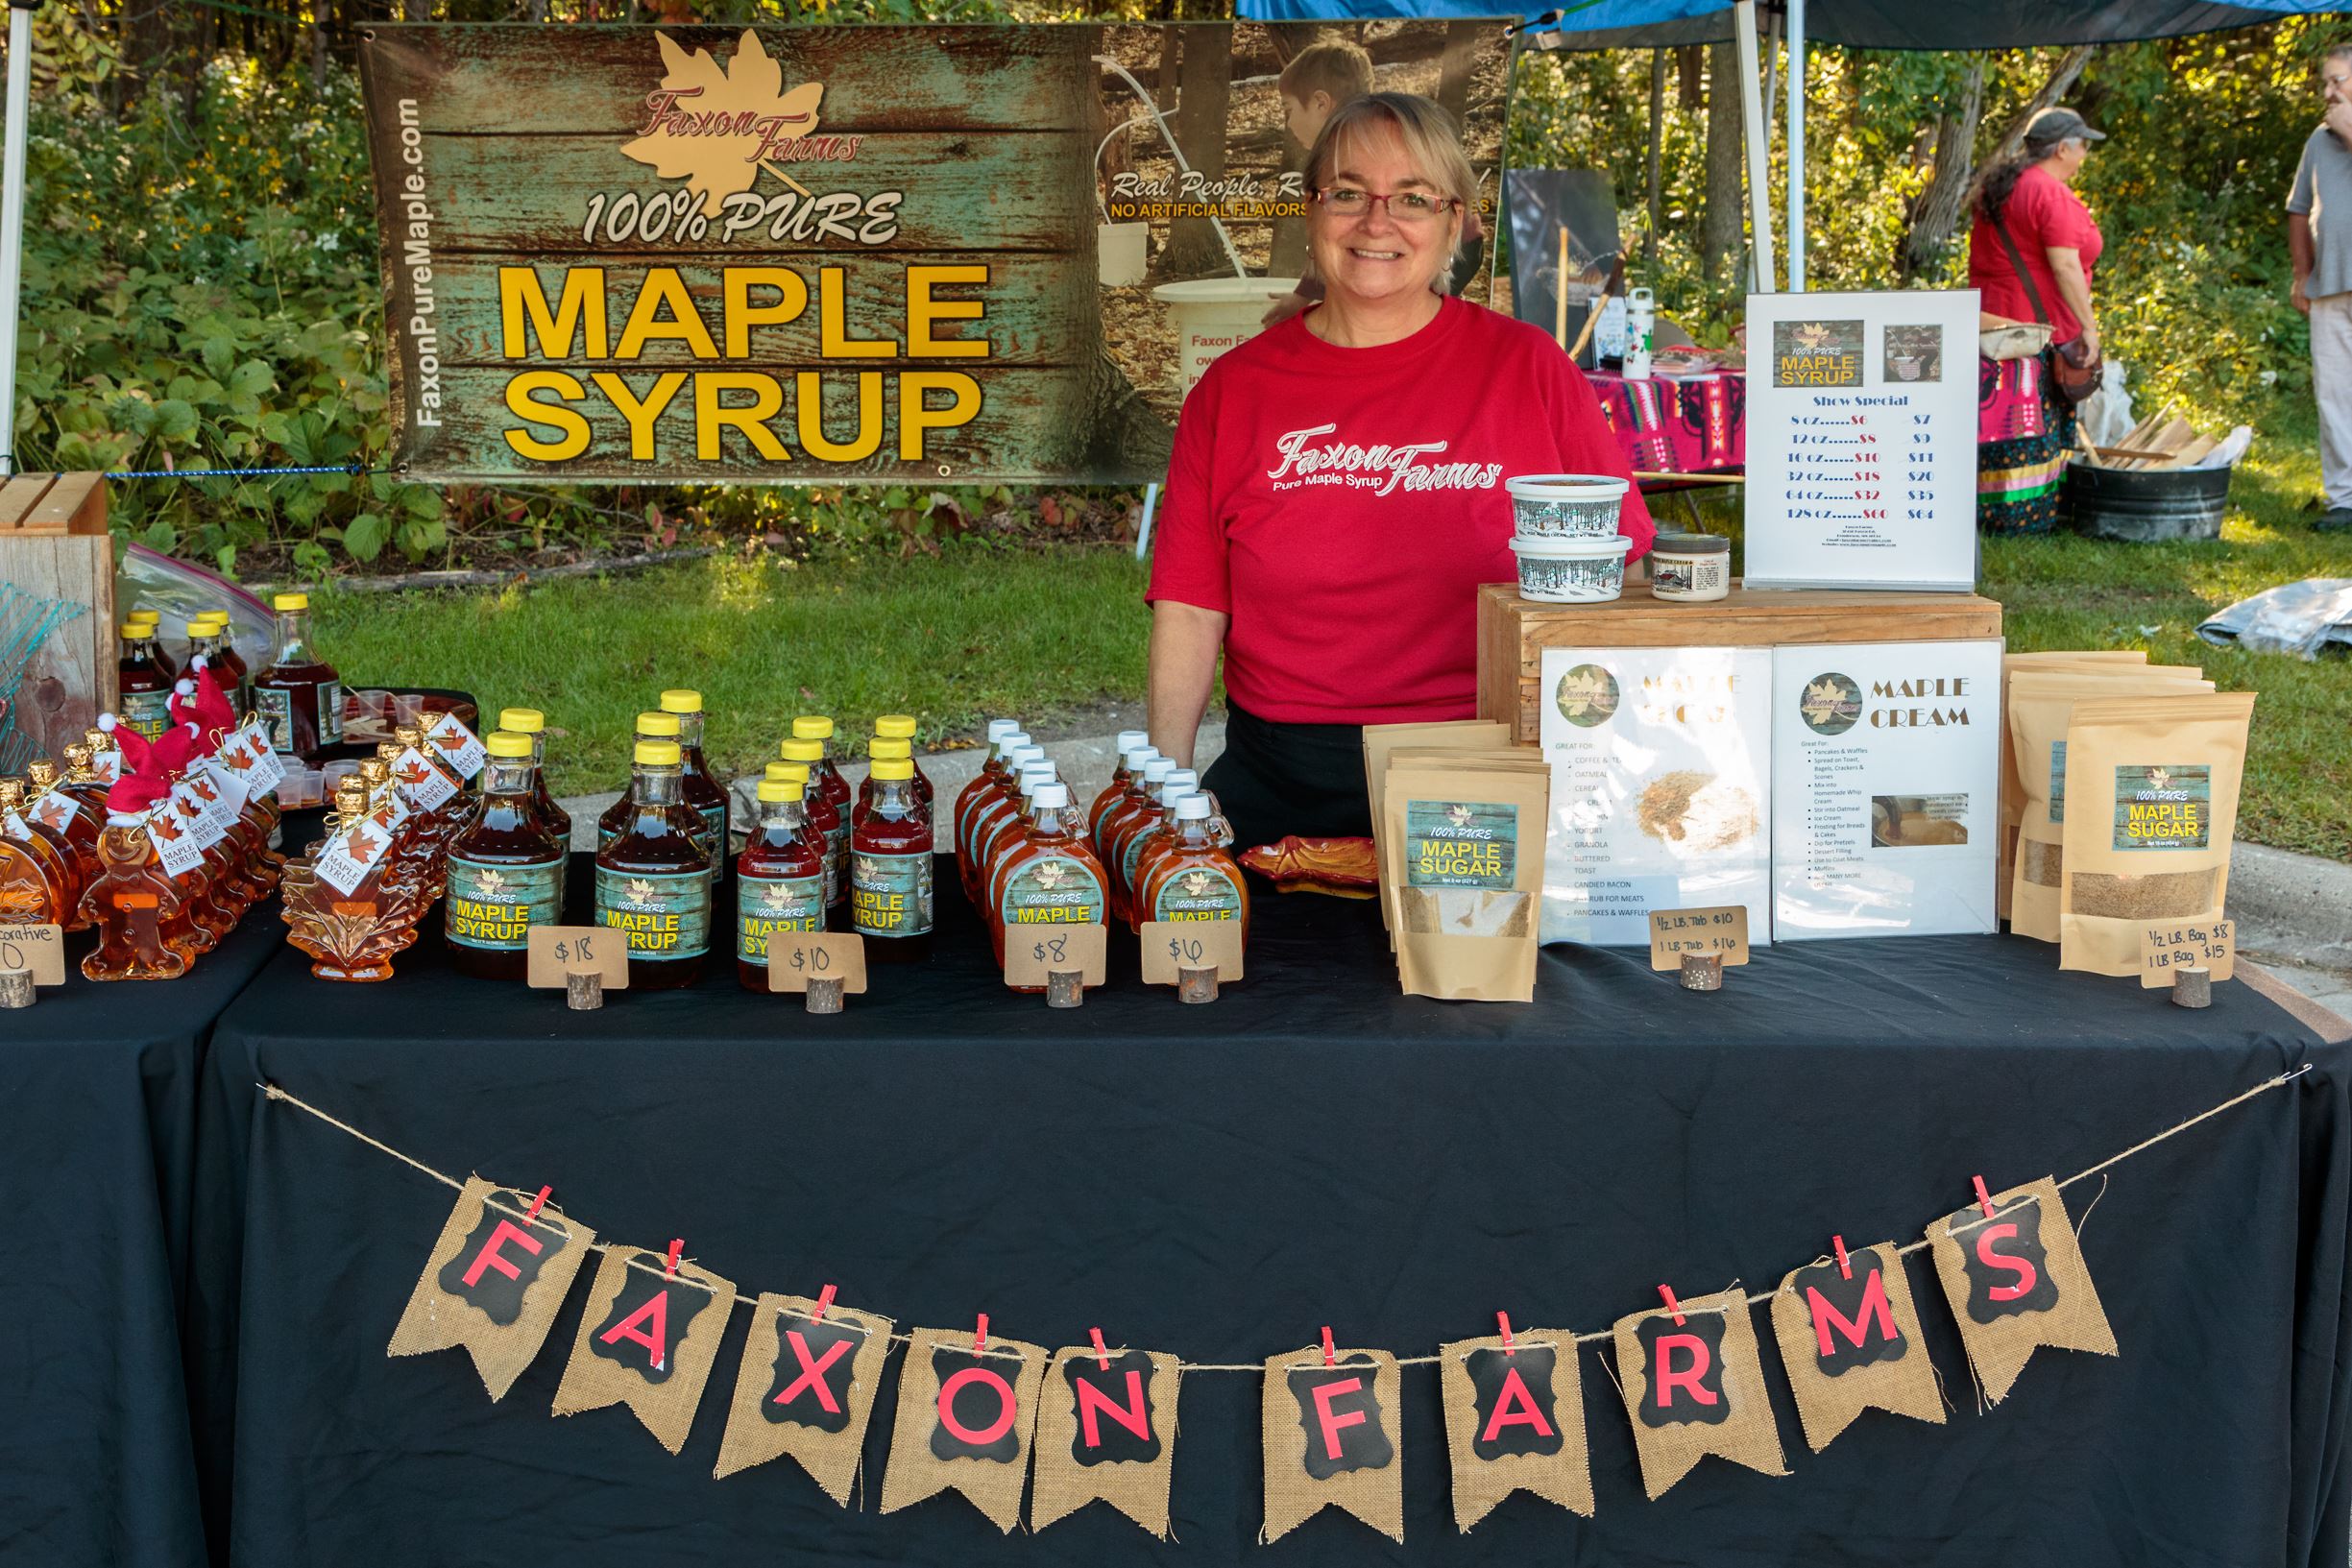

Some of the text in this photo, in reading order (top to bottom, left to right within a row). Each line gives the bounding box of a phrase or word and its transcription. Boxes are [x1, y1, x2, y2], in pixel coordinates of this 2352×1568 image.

[636, 84, 863, 162] Faxon Farms
[1111, 172, 1172, 197] Real
[582, 192, 905, 243] 100% PURE
[1111, 203, 1136, 217] NO
[1139, 203, 1230, 217] ARTIFICIAL
[401, 98, 444, 428] FaxonPureMaple.com
[498, 265, 989, 360] MAPLE
[1192, 336, 1232, 347] Faxon
[1782, 355, 1855, 371] MAPLE
[1782, 371, 1855, 385] SYRUP
[1812, 395, 1908, 407] Show Special
[502, 370, 982, 462] SYRUP
[1267, 422, 1503, 497] Faxon Farms
[1273, 472, 1383, 492] Pure Maple Syrup
[1870, 677, 1971, 699] MAPLE
[1870, 707, 1971, 729] CREAM
[456, 744, 482, 768] MAPLE
[417, 779, 446, 804] MAPLE
[423, 784, 450, 809] SYRUP
[2136, 790, 2189, 801] 100% PURE
[2129, 804, 2197, 821] MAPLE
[192, 819, 216, 836] MAPLE
[196, 825, 222, 843] SYRUP
[1430, 827, 1492, 839] 100% PURE
[2127, 821, 2198, 838] SUGAR
[163, 844, 195, 861] MAPLE
[167, 850, 198, 868] SYRUP
[1422, 840, 1500, 859] MAPLE
[322, 860, 356, 888] SYRUP
[327, 854, 361, 881] MAPLE
[1419, 857, 1501, 877] SUGAR
[467, 890, 517, 904] 100% PURE
[617, 901, 666, 912] 100% PURE
[854, 891, 904, 911] APLE
[1026, 893, 1081, 904] 100% PURE
[1176, 899, 1224, 908] 100% PURE
[456, 899, 529, 922] MAPLE
[607, 909, 679, 931] MAPLE
[756, 907, 806, 917] 100% PURE
[854, 909, 903, 929] YRUP
[1018, 905, 1090, 923] MAPLE
[1713, 913, 1734, 925] $10
[456, 917, 527, 940] SYRUP
[2168, 930, 2186, 945] LB.
[2188, 929, 2207, 947] Bag
[2213, 924, 2228, 939] $8
[1667, 941, 1681, 952] LB
[1712, 937, 1735, 950] $16
[789, 947, 830, 972] $10
[2157, 953, 2170, 967] LB
[2173, 951, 2194, 967] Bag
[2204, 945, 2225, 958] $15
